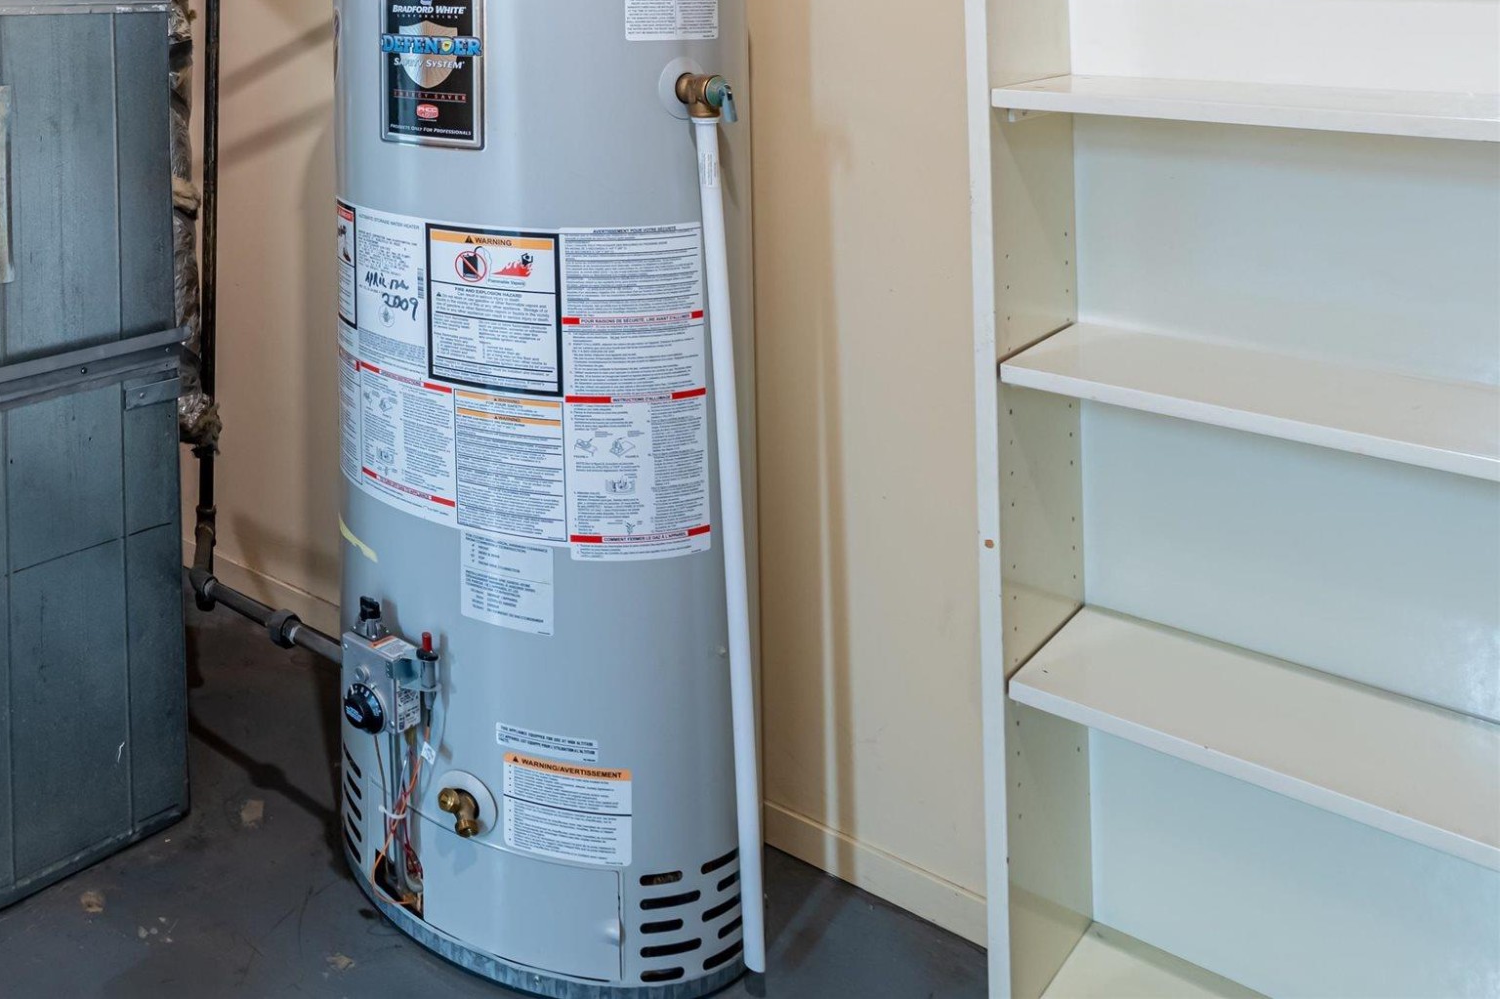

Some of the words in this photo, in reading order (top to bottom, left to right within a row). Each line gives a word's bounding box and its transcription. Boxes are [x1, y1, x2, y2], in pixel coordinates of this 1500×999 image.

[392, 4, 434, 14] BRADFORD
[435, 6, 465, 15] WHITE
[381, 33, 483, 57] DEFENDER
[426, 59, 464, 70] SYSTEM
[434, 93, 467, 101] SAVER
[433, 127, 472, 136] PROFESSIONALS
[474, 236, 512, 247] WARNING
[475, 289, 502, 297] EXPLOSION
[382, 292, 419, 322] 2009
[521, 757, 623, 779] WARNING/AVERTISSEMENT
